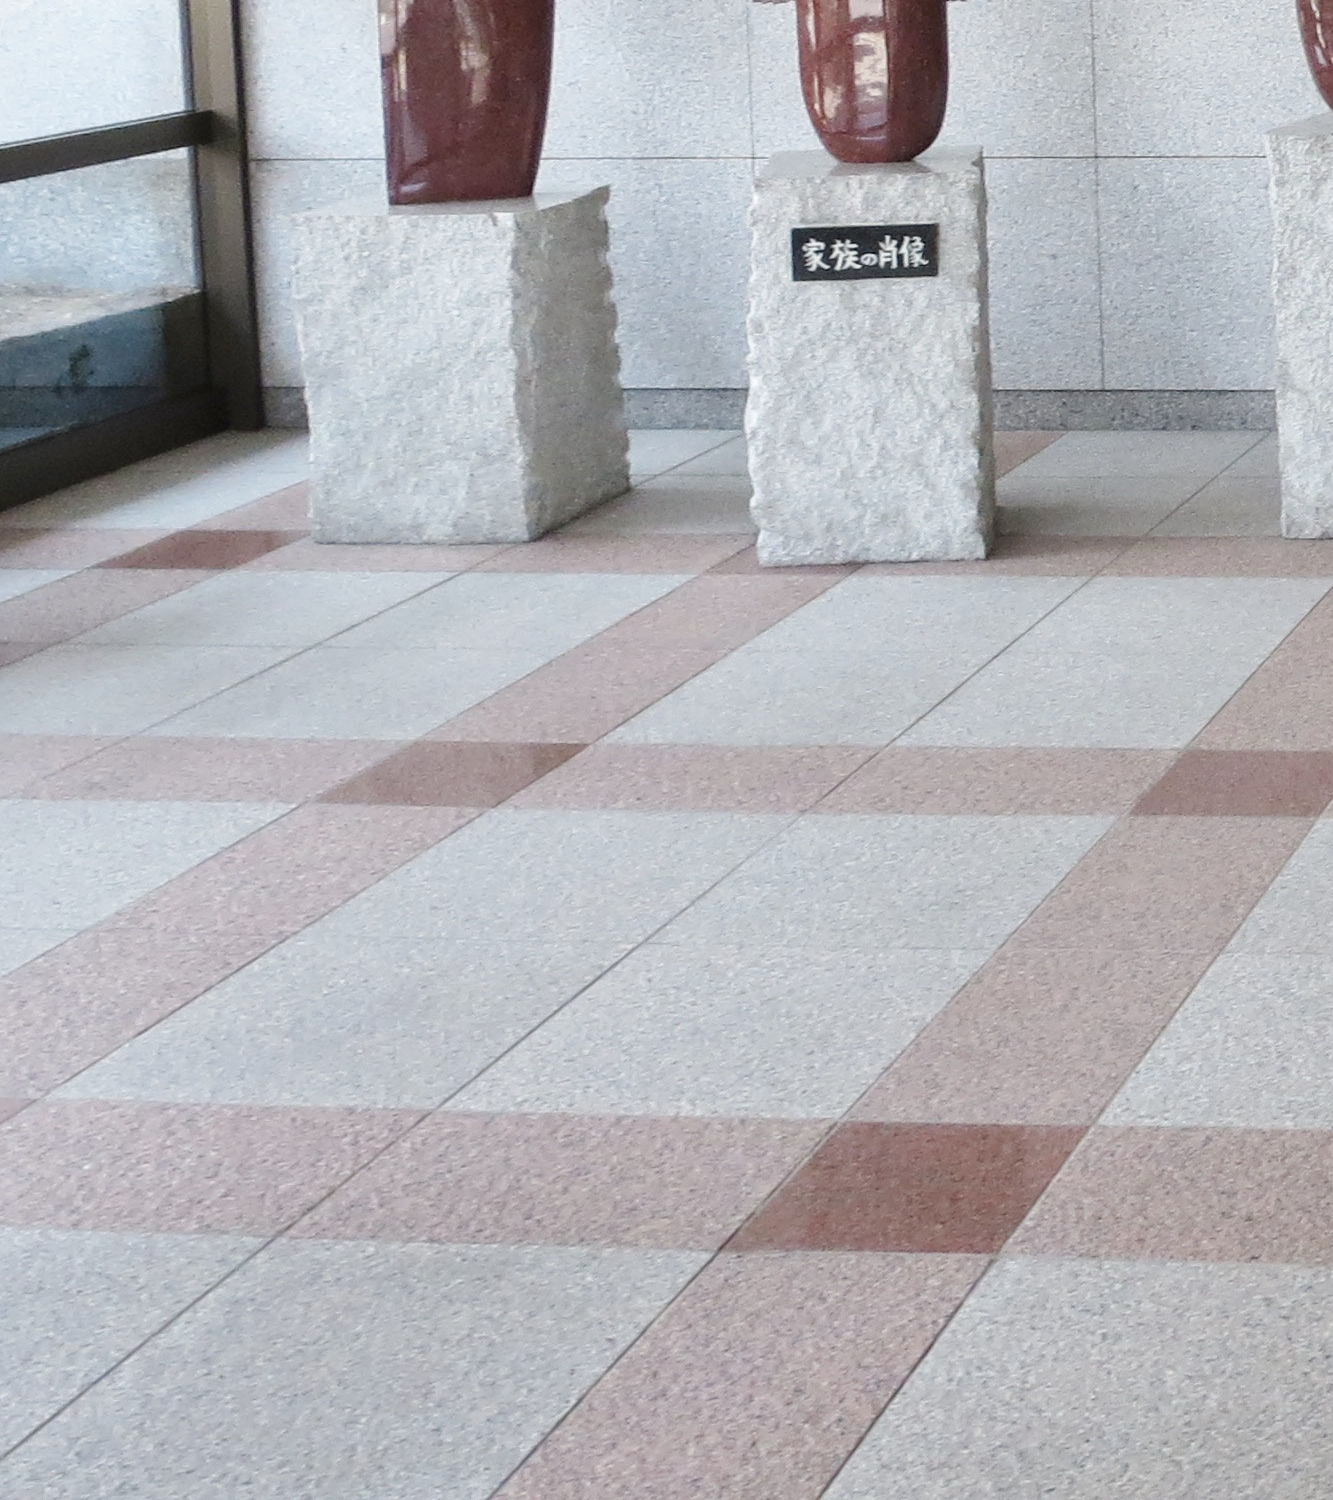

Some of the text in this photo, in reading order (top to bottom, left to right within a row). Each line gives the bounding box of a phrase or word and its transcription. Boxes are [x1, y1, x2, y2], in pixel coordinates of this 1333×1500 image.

[801, 234, 930, 272] 家族の肖像
